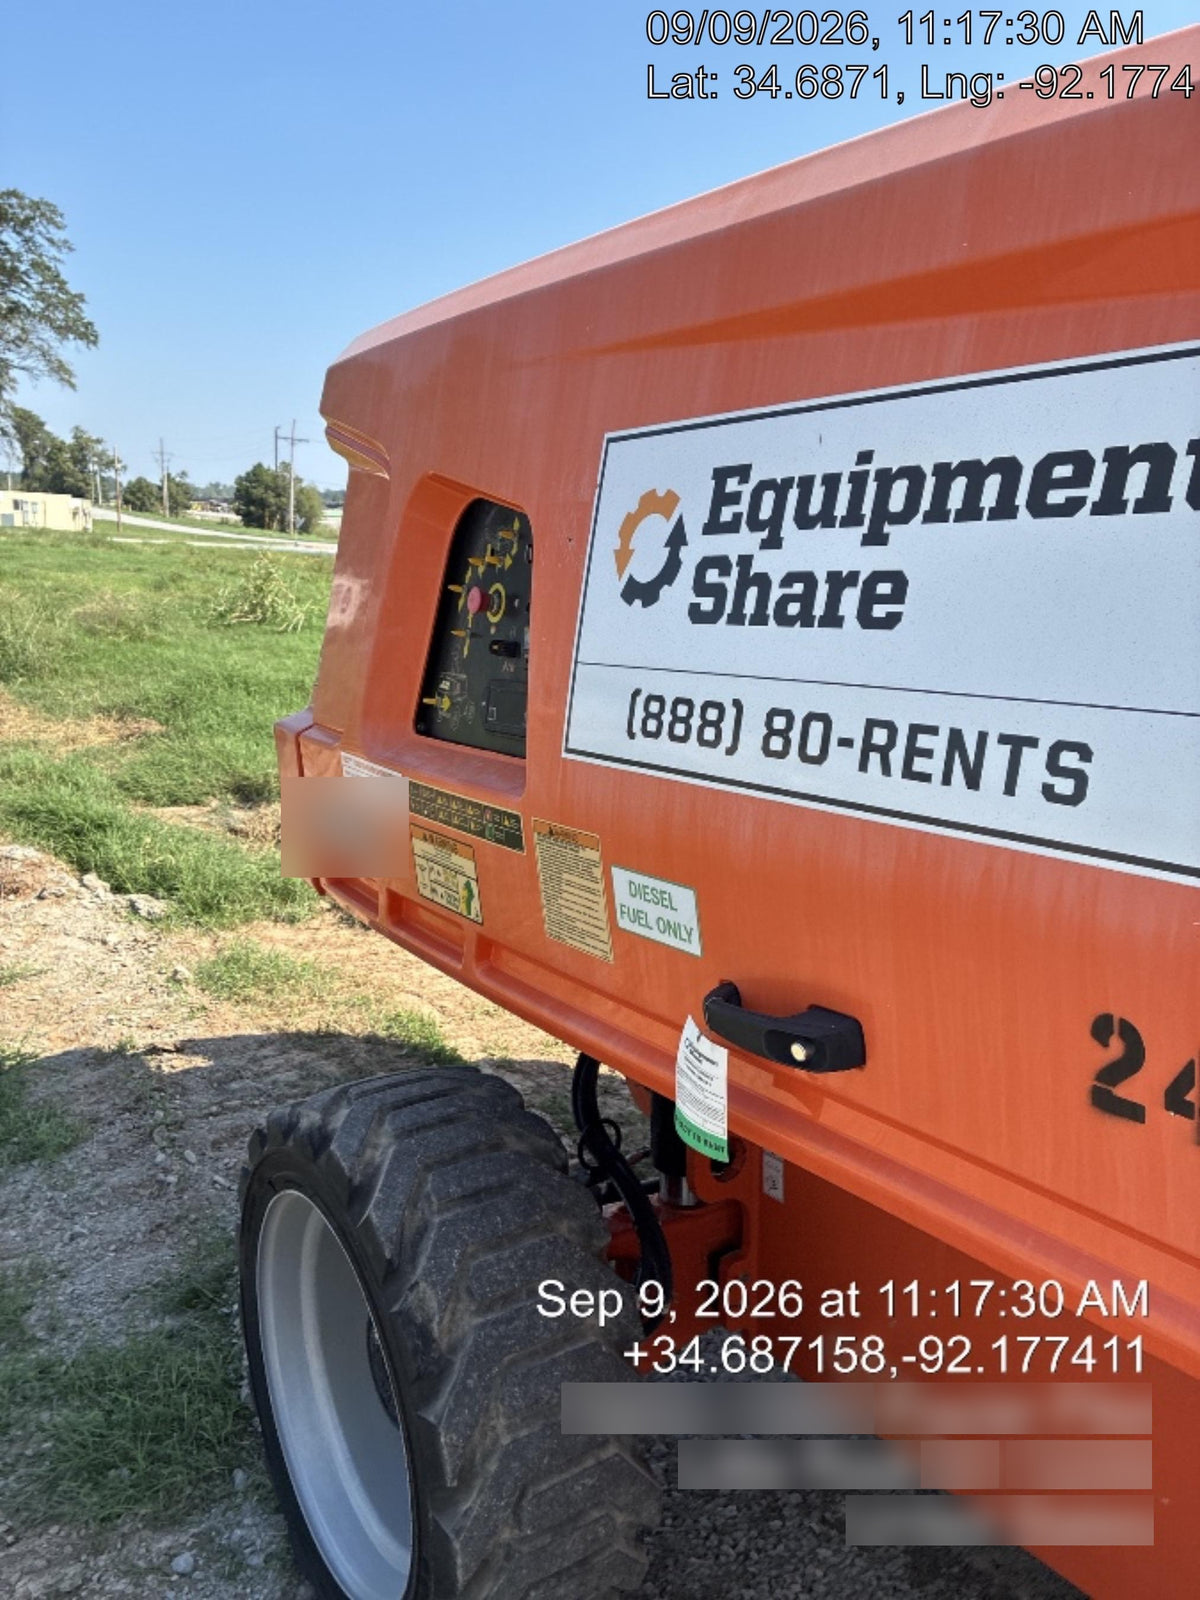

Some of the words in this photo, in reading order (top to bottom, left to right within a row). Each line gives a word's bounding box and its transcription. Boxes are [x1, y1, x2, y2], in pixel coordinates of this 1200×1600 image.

[687, 554, 909, 630] Share
[626, 688, 744, 756] (888)
[761, 708, 1094, 807] 80-RENTS
[619, 904, 653, 931] FUEL
[656, 917, 694, 945] ONLY
[628, 879, 678, 912] DIESEL
